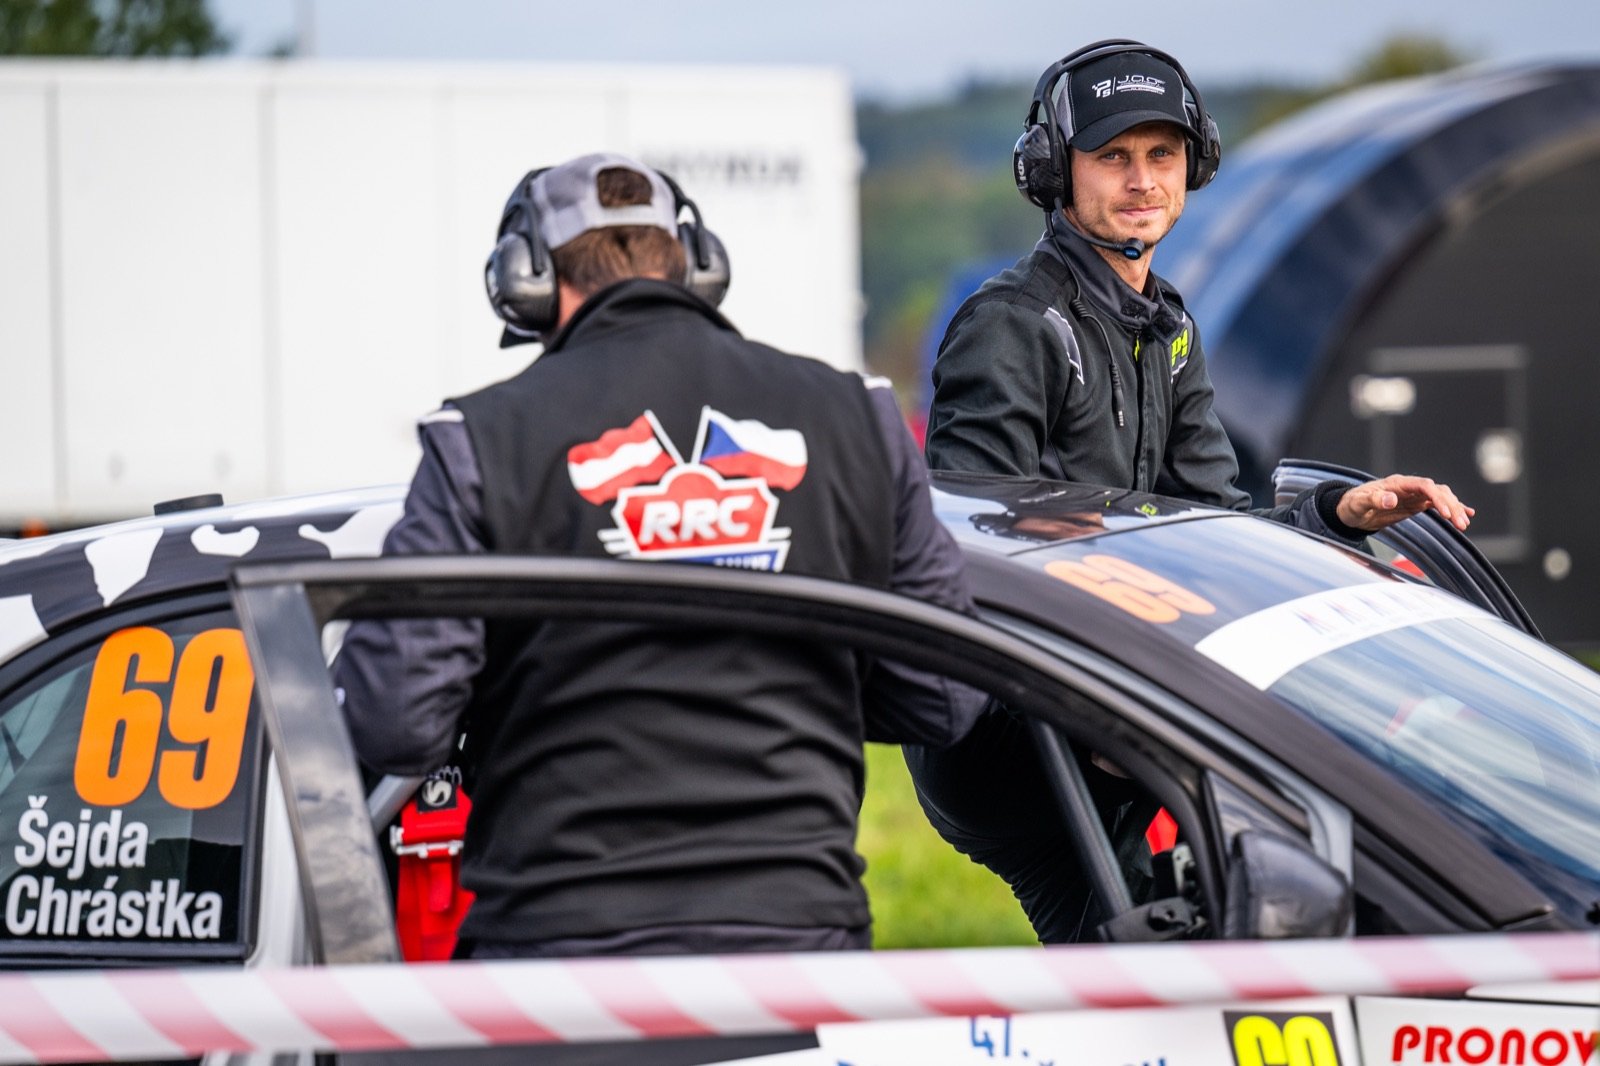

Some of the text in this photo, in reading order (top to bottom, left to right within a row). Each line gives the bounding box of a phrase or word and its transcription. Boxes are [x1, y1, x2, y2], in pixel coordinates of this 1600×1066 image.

[639, 495, 754, 543] RRC
[73, 626, 255, 810] 69
[14, 795, 149, 880] Šejda
[5, 875, 223, 939] Chrástka
